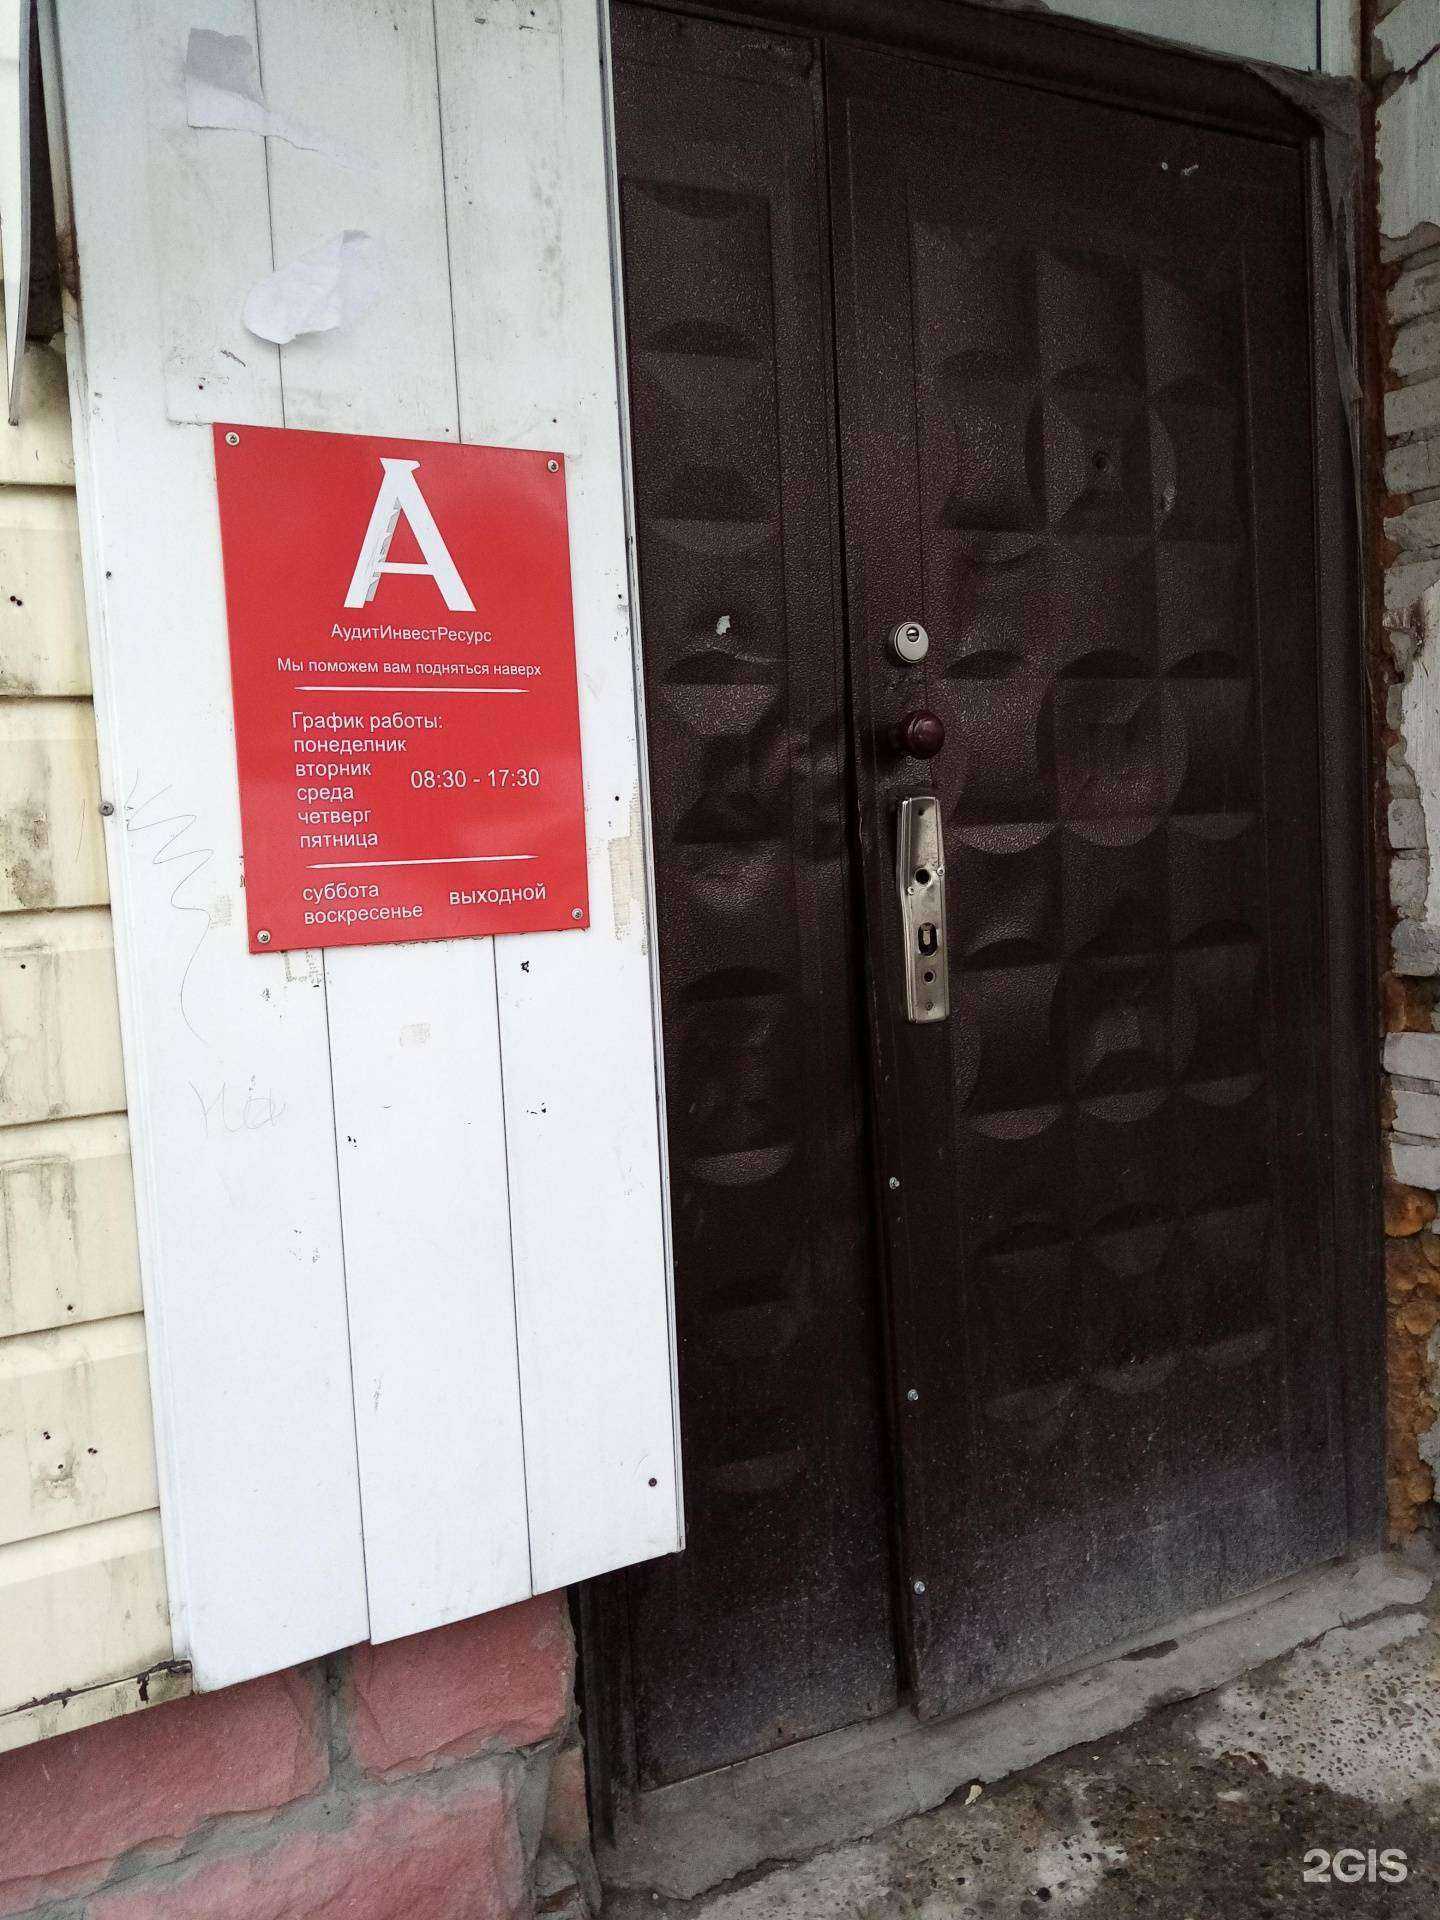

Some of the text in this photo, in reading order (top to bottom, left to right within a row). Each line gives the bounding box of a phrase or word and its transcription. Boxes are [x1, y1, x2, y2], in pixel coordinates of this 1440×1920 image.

[343, 457, 477, 612] А
[330, 623, 492, 645] АудитИнвестРесурс
[277, 657, 542, 677] Мы поможем вам подняться наверх
[292, 711, 443, 732] График работы:
[295, 762, 372, 780] вторник
[410, 769, 467, 789] 08:30
[487, 768, 540, 787] 17:30
[296, 785, 354, 804] среда
[297, 809, 372, 827] четверг
[300, 832, 378, 850] пятница
[302, 883, 379, 904] суббота
[449, 882, 547, 905] выходной
[304, 904, 423, 925] воскресенье
